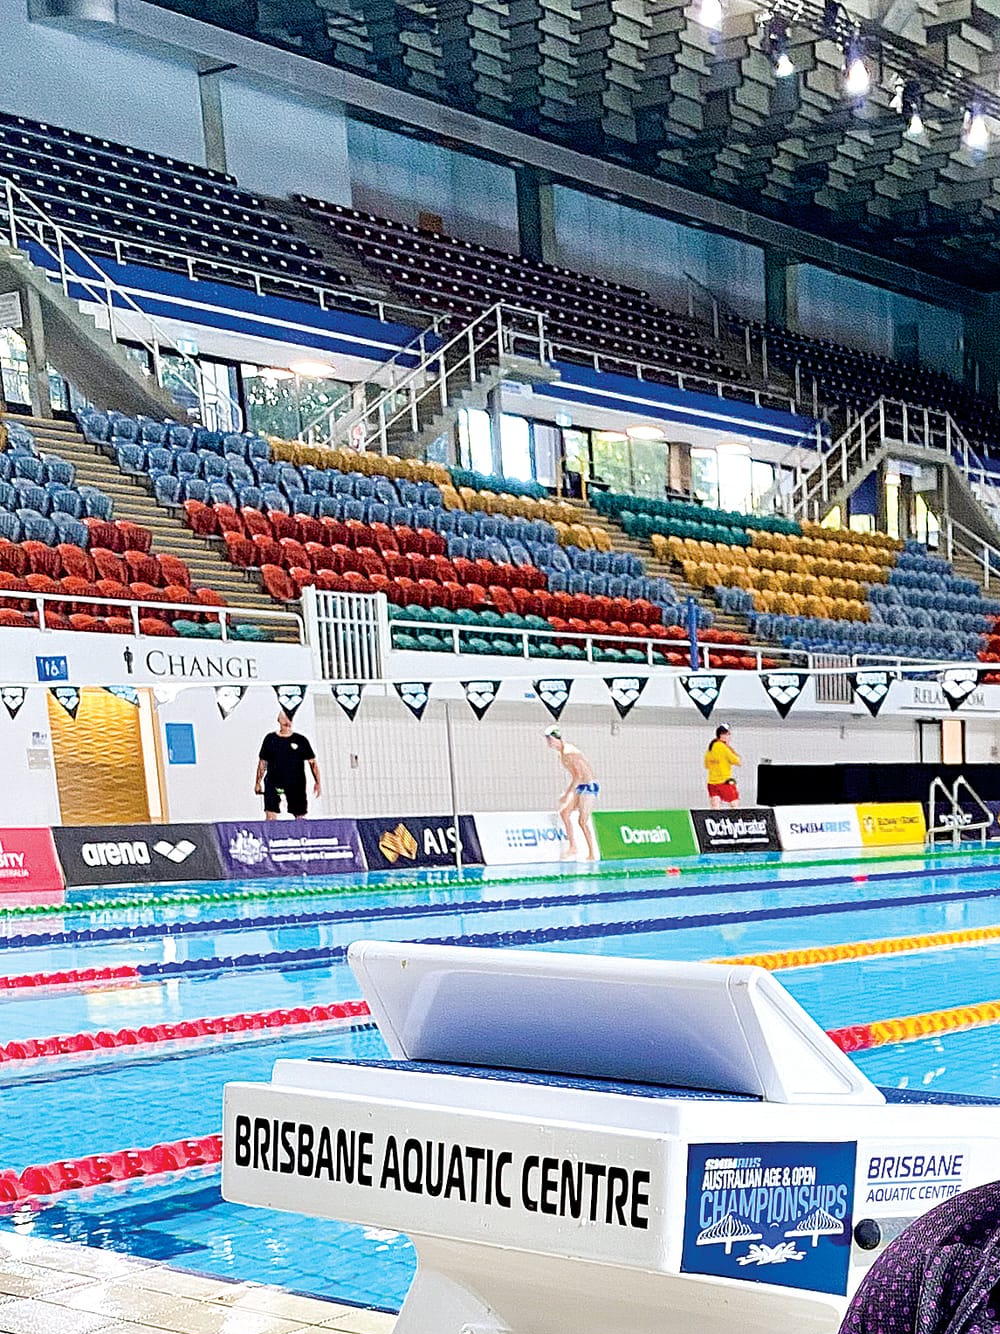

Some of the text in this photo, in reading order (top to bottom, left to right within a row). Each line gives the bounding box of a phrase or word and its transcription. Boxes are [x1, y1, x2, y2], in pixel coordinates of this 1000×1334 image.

[146, 651, 259, 679] CHANGE
[424, 827, 463, 855] AIS
[618, 825, 671, 844] Domain
[82, 841, 151, 866] arena
[235, 1114, 651, 1229] BRISBANE AQUATIC CENTRE
[702, 1166, 816, 1191] AUSTRALIAN AGE & OPEN
[867, 1154, 963, 1180] BRISBANE
[700, 1184, 848, 1229] CHAMPIONSHIPS
[866, 1187, 917, 1203] AQUATIC
